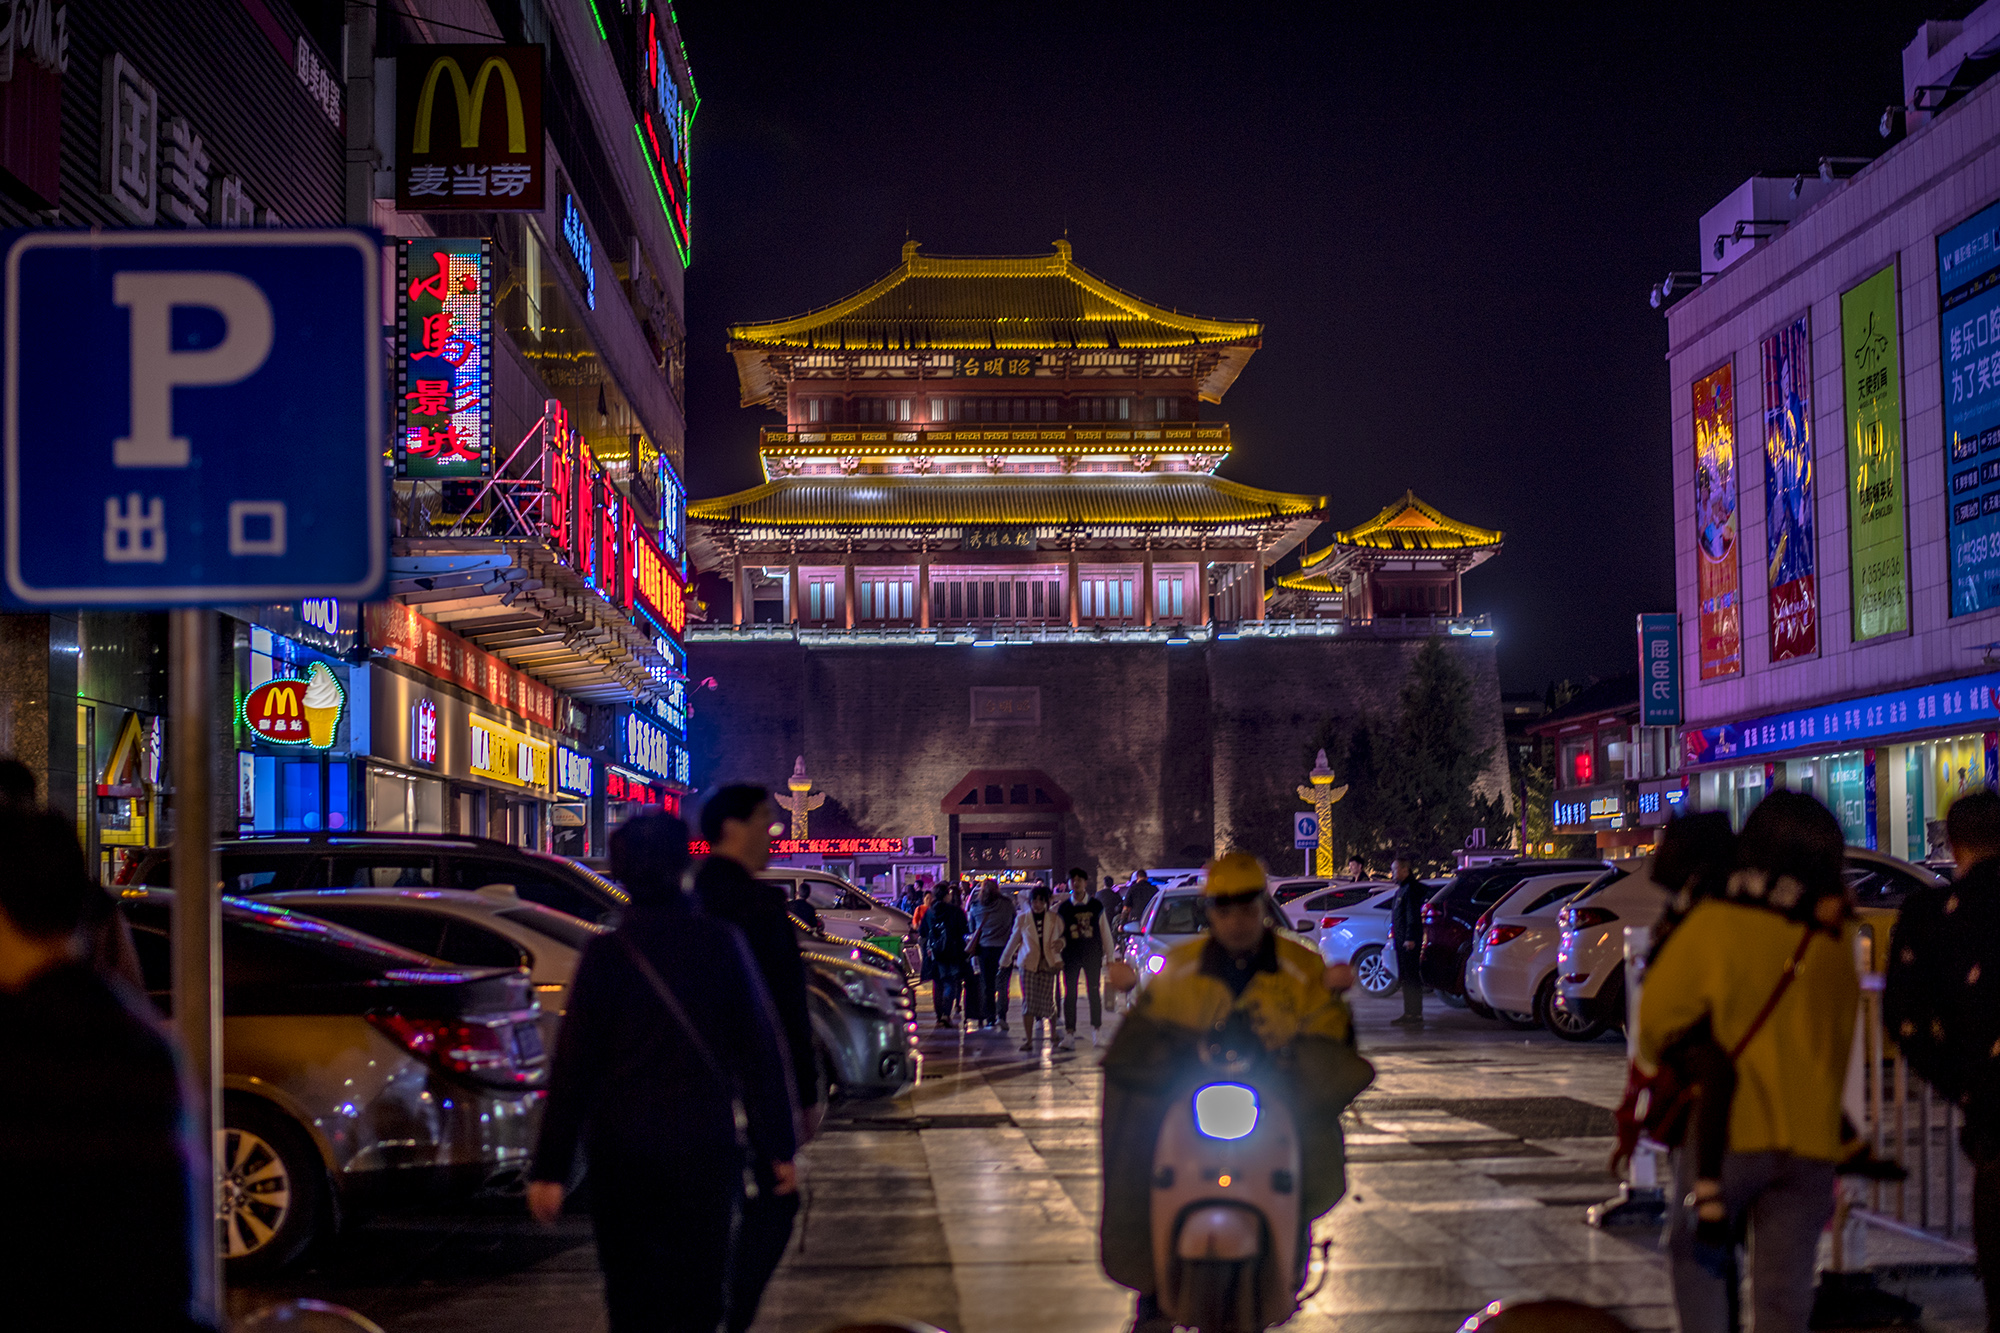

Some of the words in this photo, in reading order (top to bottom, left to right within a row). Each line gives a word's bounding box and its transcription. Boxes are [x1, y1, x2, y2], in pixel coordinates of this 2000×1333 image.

[408, 163, 532, 197] 麦当劳
[112, 270, 275, 469] P
[1857, 367, 1888, 402] 天使教育
[103, 493, 287, 563] 出口
[1744, 728, 1759, 749] 富强
[1762, 725, 1777, 746] 民主
[1780, 720, 1796, 741] 文明
[1800, 717, 1815, 738] 和谐
[1824, 713, 1839, 736] 自由
[1844, 710, 1860, 732] 平等
[1866, 705, 1883, 727] 公正
[1890, 701, 1908, 724] 法治
[1918, 695, 1936, 719] 爱国
[1943, 691, 1963, 715] 敬业
[1970, 685, 1990, 711] 诚信
